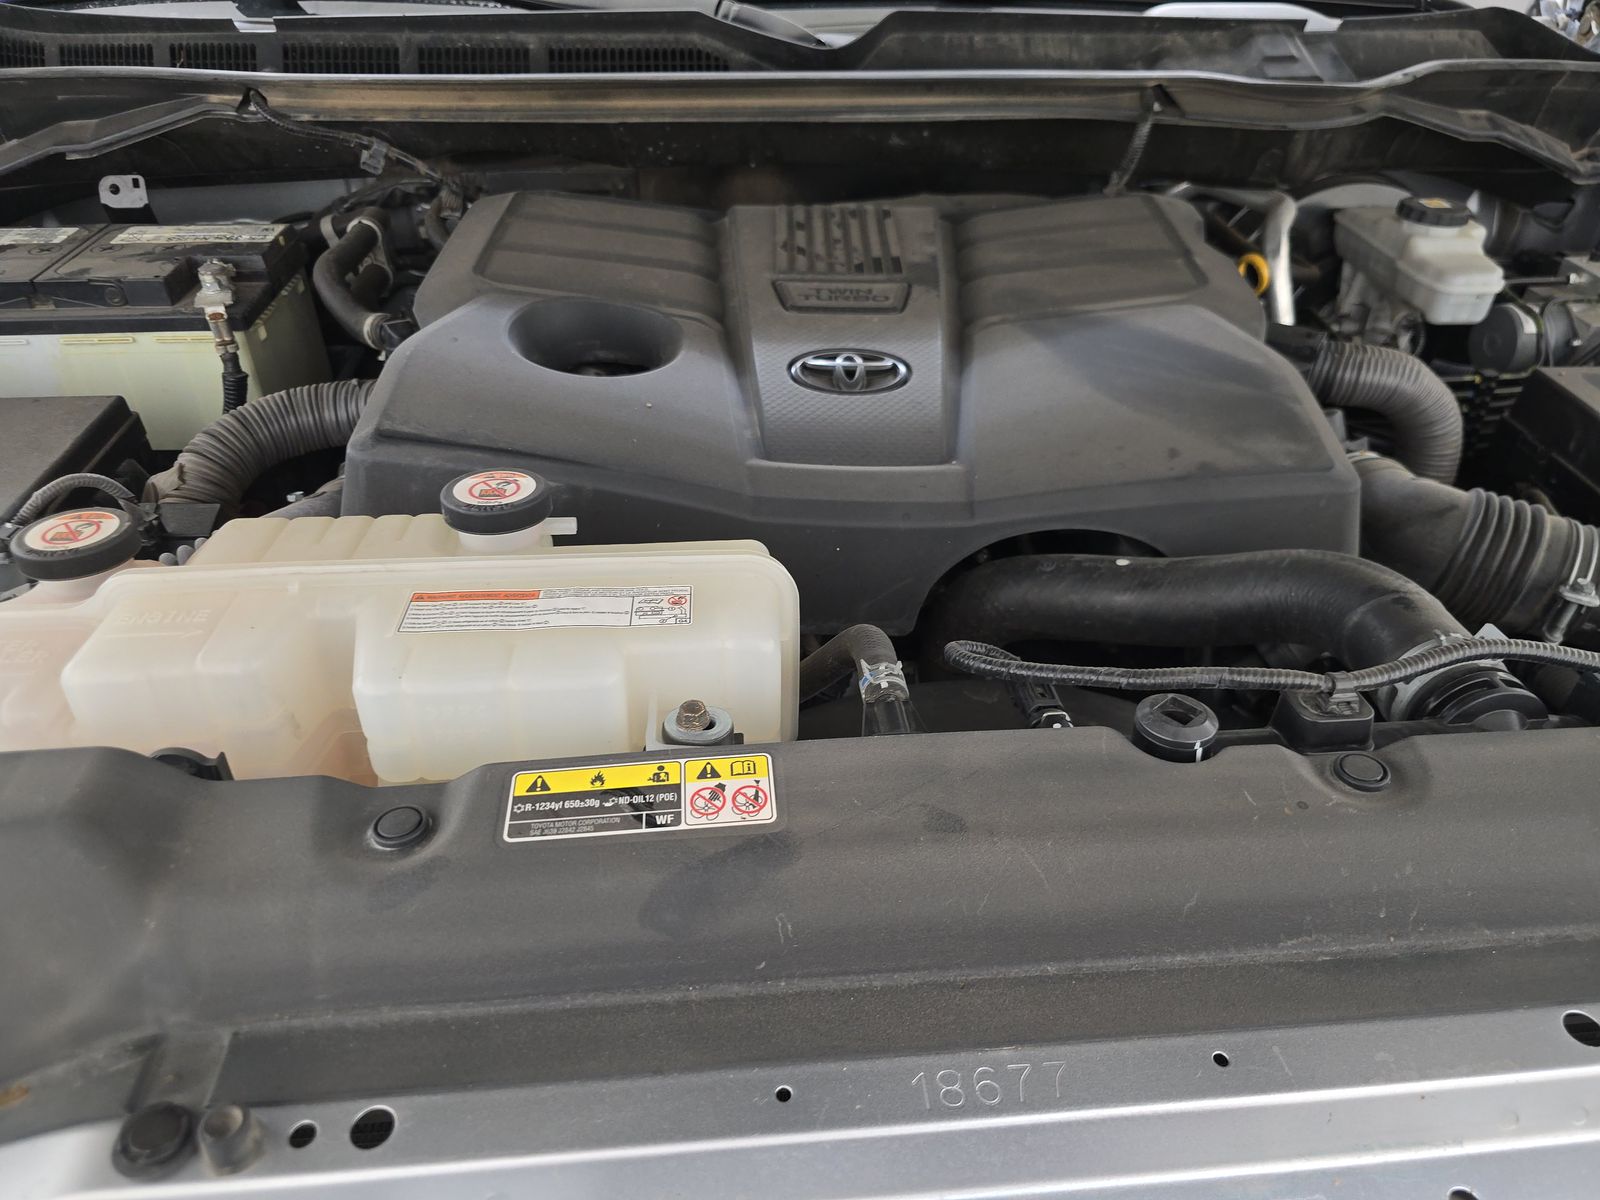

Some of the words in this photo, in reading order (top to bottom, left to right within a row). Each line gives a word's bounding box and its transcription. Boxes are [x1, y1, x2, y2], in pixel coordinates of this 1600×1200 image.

[797, 294, 890, 302] TURBO
[809, 288, 873, 296] TWIN
[116, 610, 212, 624] ENGINE
[525, 801, 562, 811] R-1234yf
[564, 799, 600, 808] 650±30g
[619, 794, 655, 805] ND-OIL12
[656, 792, 678, 803] (POE)
[530, 822, 554, 830] TOYOTA
[555, 820, 577, 828] MOTOR
[578, 817, 620, 827] CORPORATION
[655, 814, 675, 825] WF
[911, 1060, 1067, 1109] 18677
